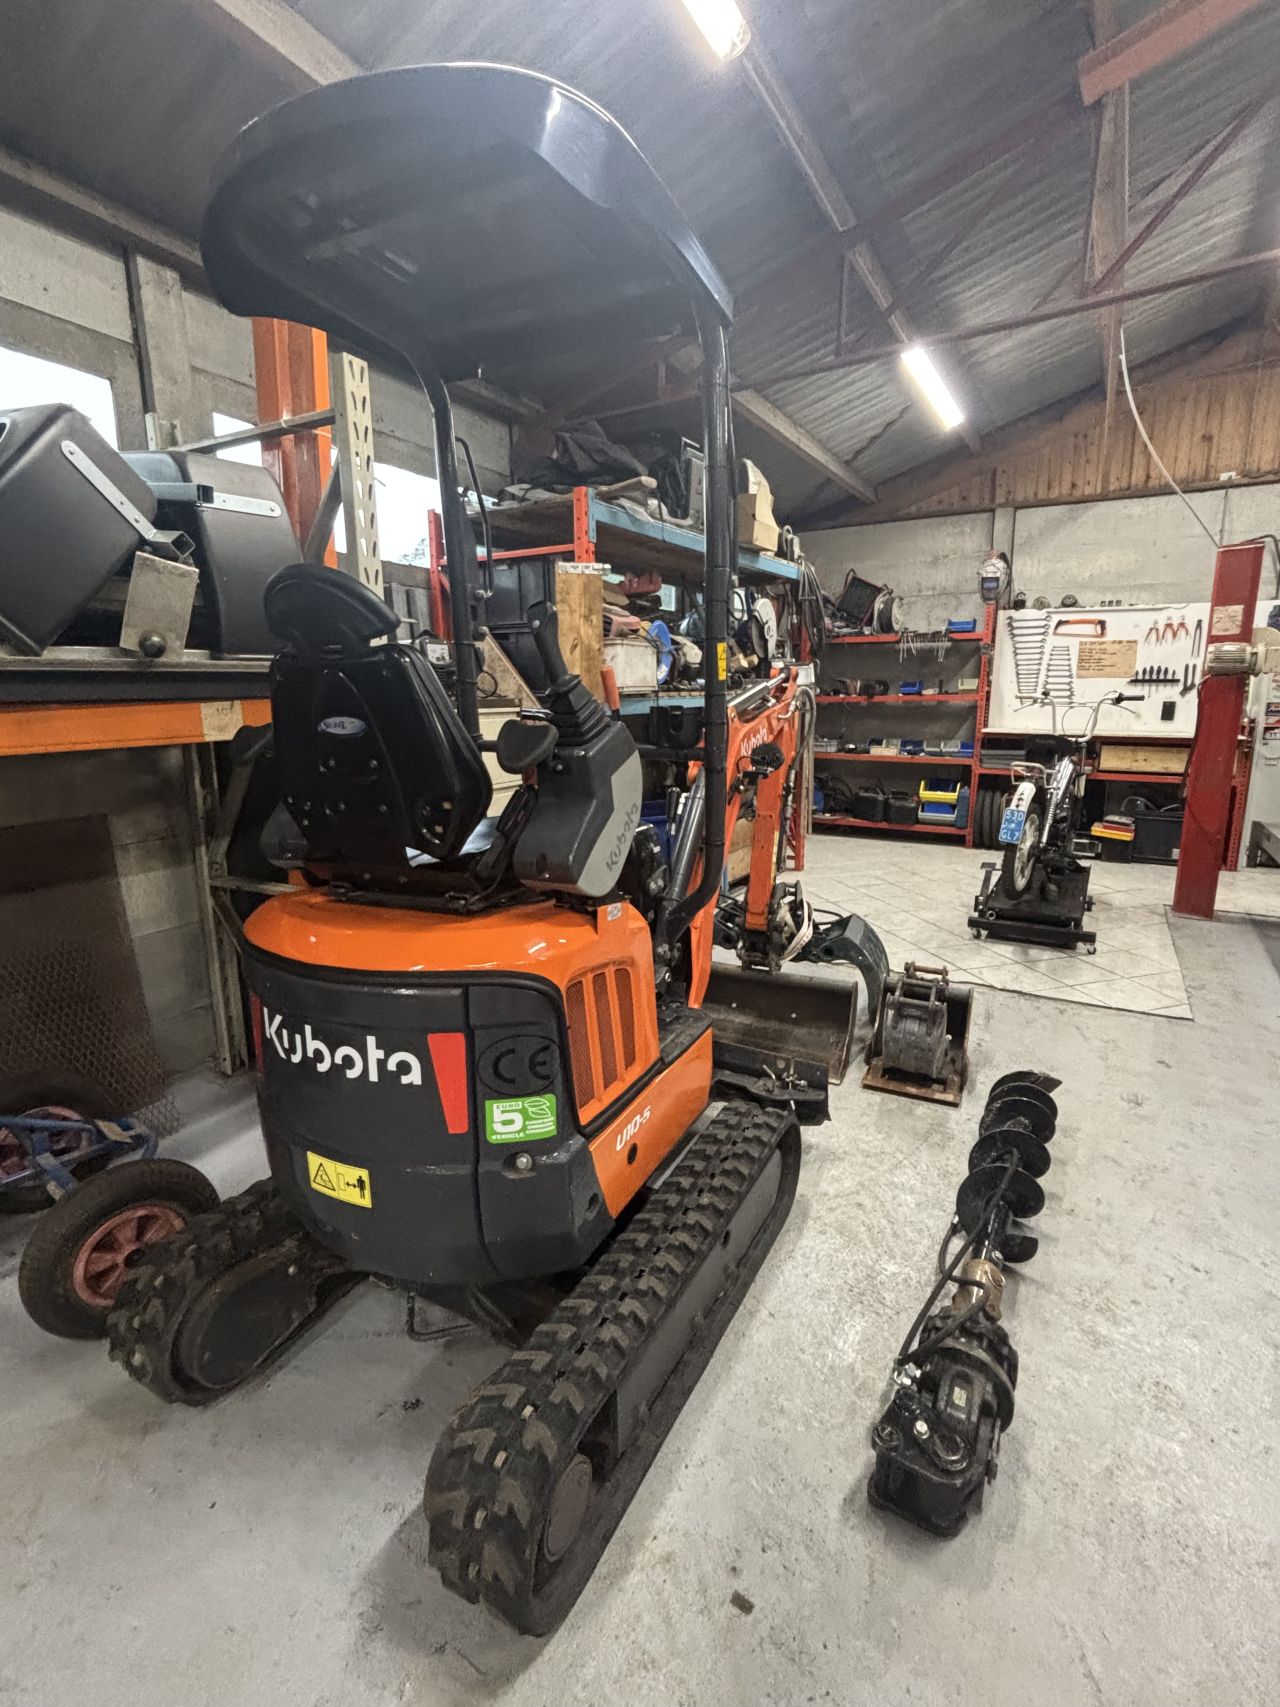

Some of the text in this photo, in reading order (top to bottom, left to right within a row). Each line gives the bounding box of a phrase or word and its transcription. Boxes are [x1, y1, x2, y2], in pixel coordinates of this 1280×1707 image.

[741, 725, 768, 757] Kubota
[606, 802, 638, 873] Kubota
[263, 1006, 422, 1085] Kubota
[492, 1044, 551, 1084] CE
[493, 1103, 523, 1133] 5
